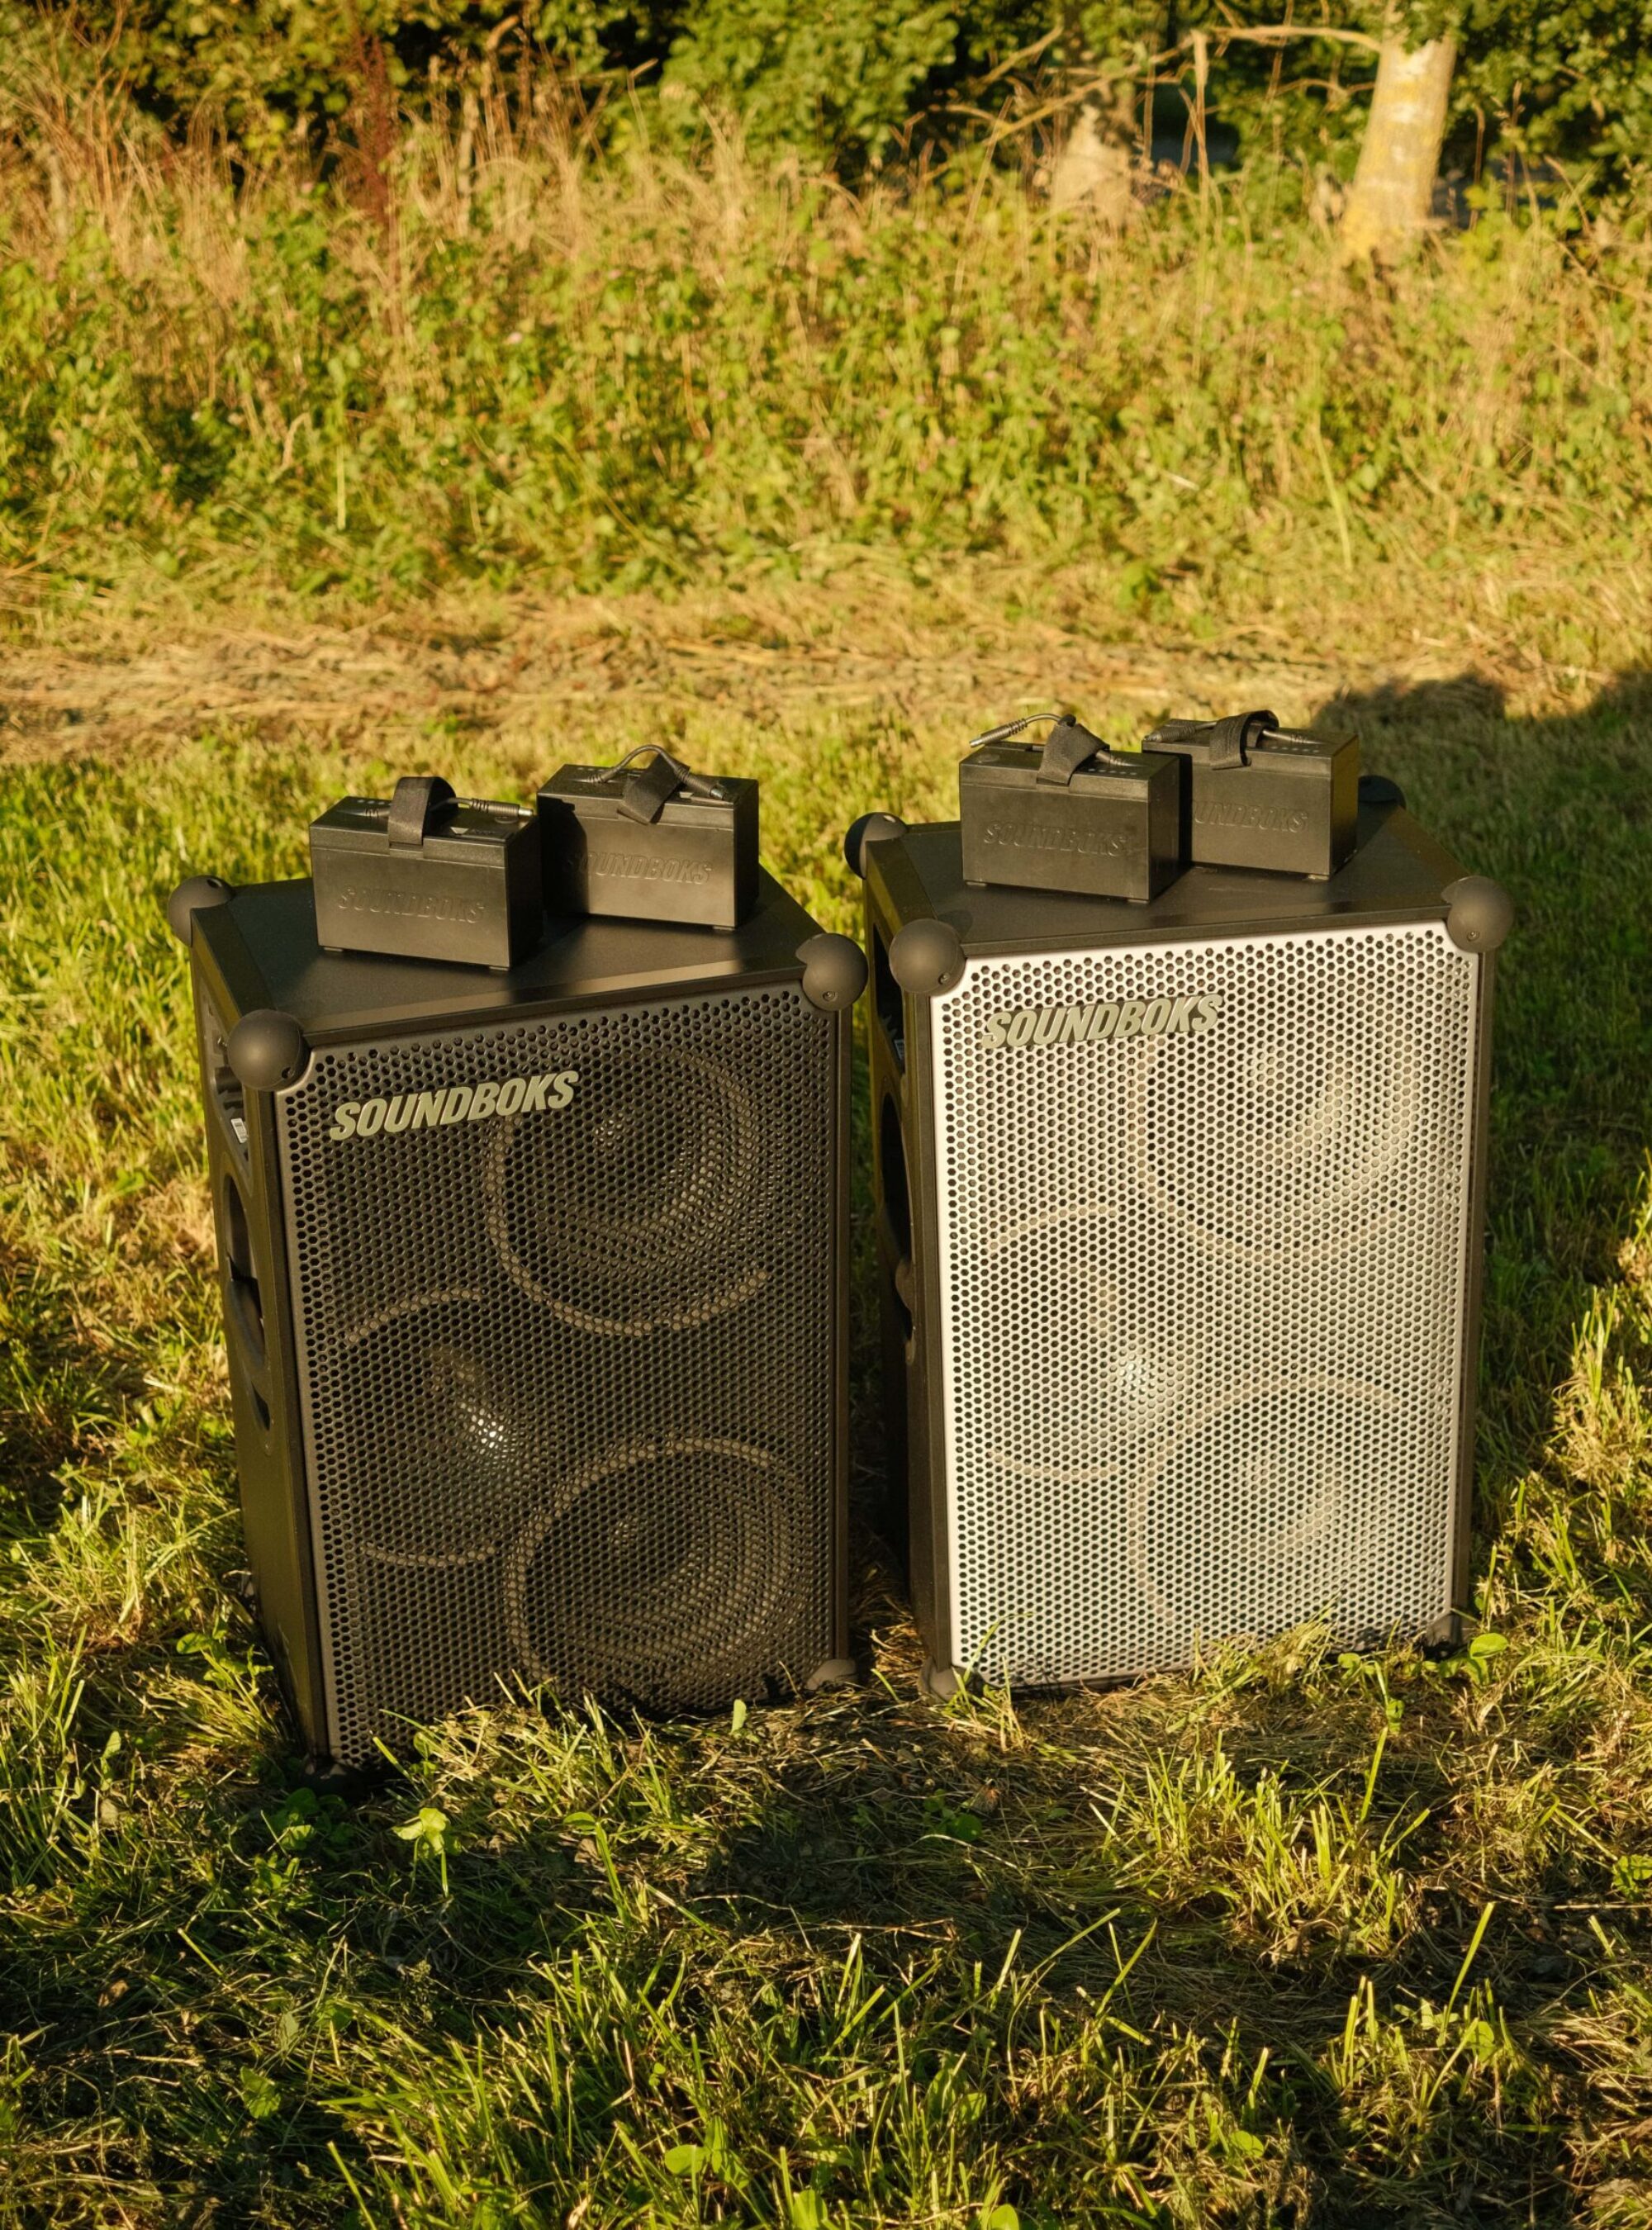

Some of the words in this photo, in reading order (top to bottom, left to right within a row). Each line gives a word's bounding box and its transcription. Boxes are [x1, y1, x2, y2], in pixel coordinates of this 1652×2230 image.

[1191, 799, 1308, 833] UNDBOKS
[983, 821, 1127, 856] SOUNDBOKS
[338, 886, 485, 923] SOUNDBOKS
[980, 994, 1223, 1049] SOUNDBOKS
[330, 1070, 578, 1141] SOUNDBOKS
